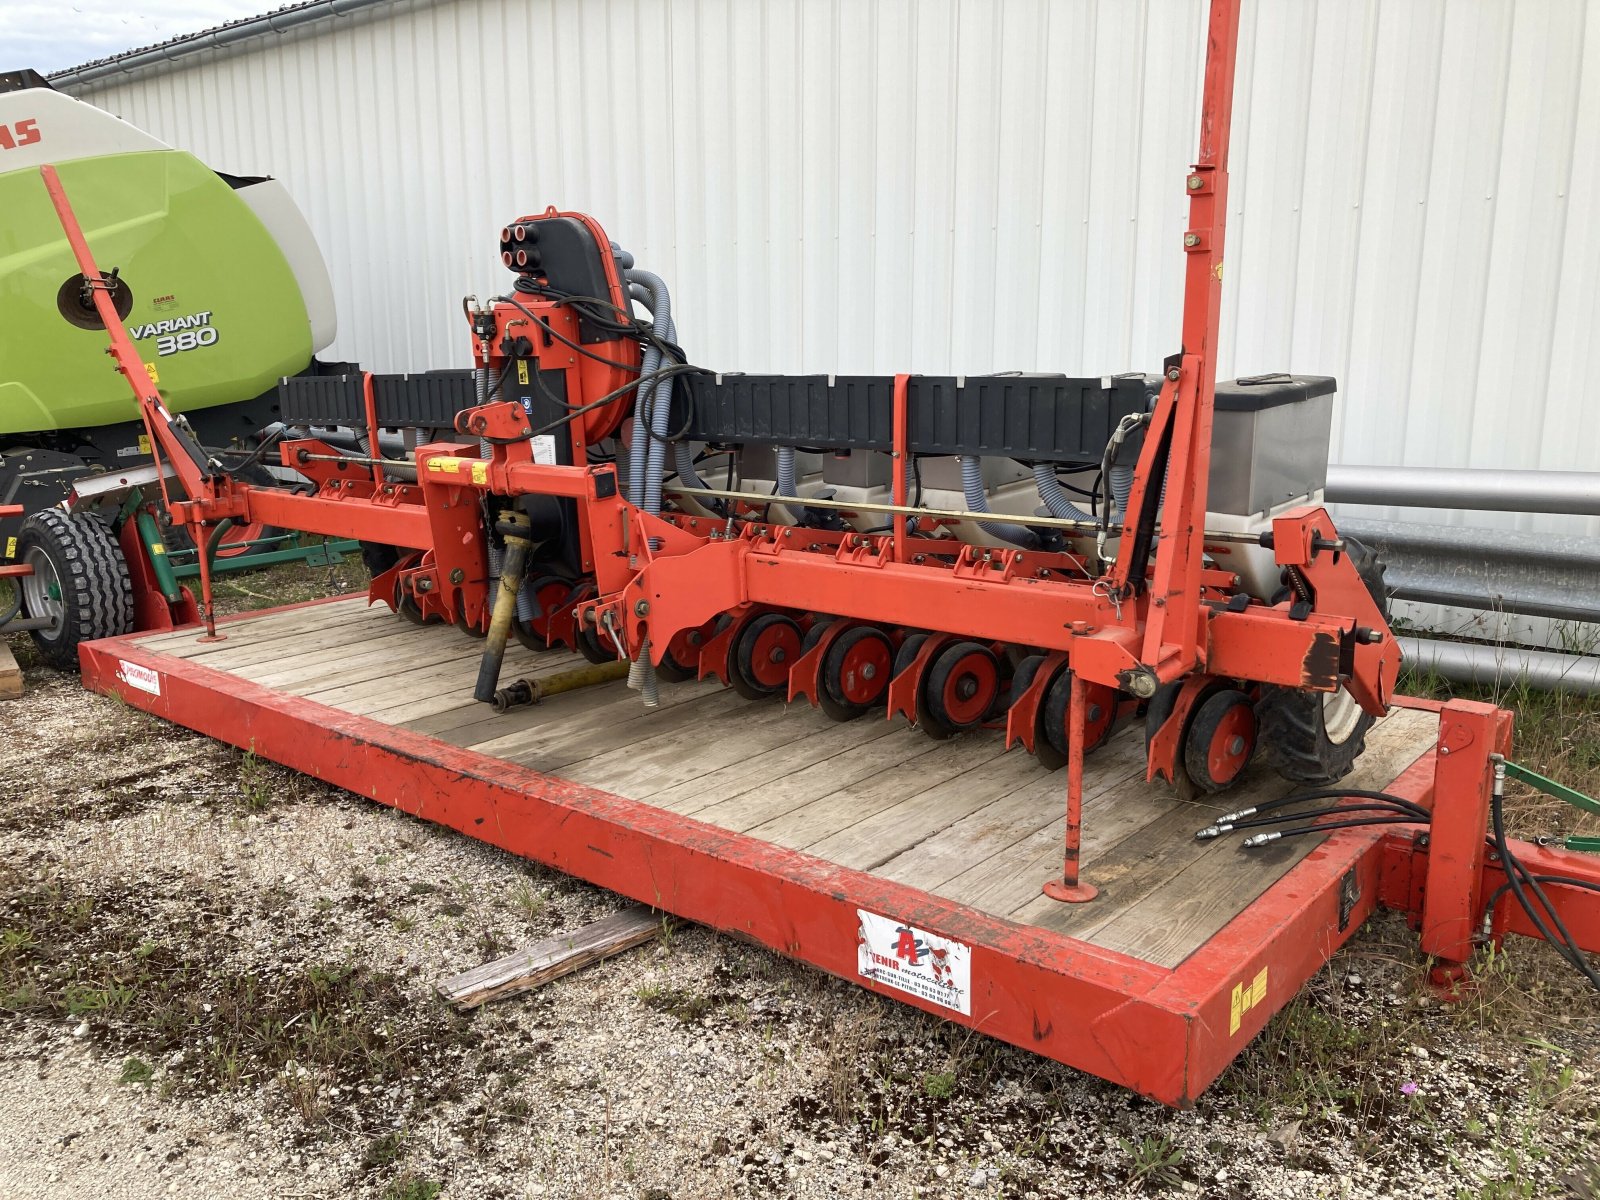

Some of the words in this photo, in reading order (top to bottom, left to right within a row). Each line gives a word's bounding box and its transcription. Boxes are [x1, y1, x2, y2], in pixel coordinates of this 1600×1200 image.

[153, 294, 175, 304] CLAAS
[130, 311, 212, 340] VARIANT
[157, 327, 218, 356] 380
[901, 968, 964, 994] motoculture
